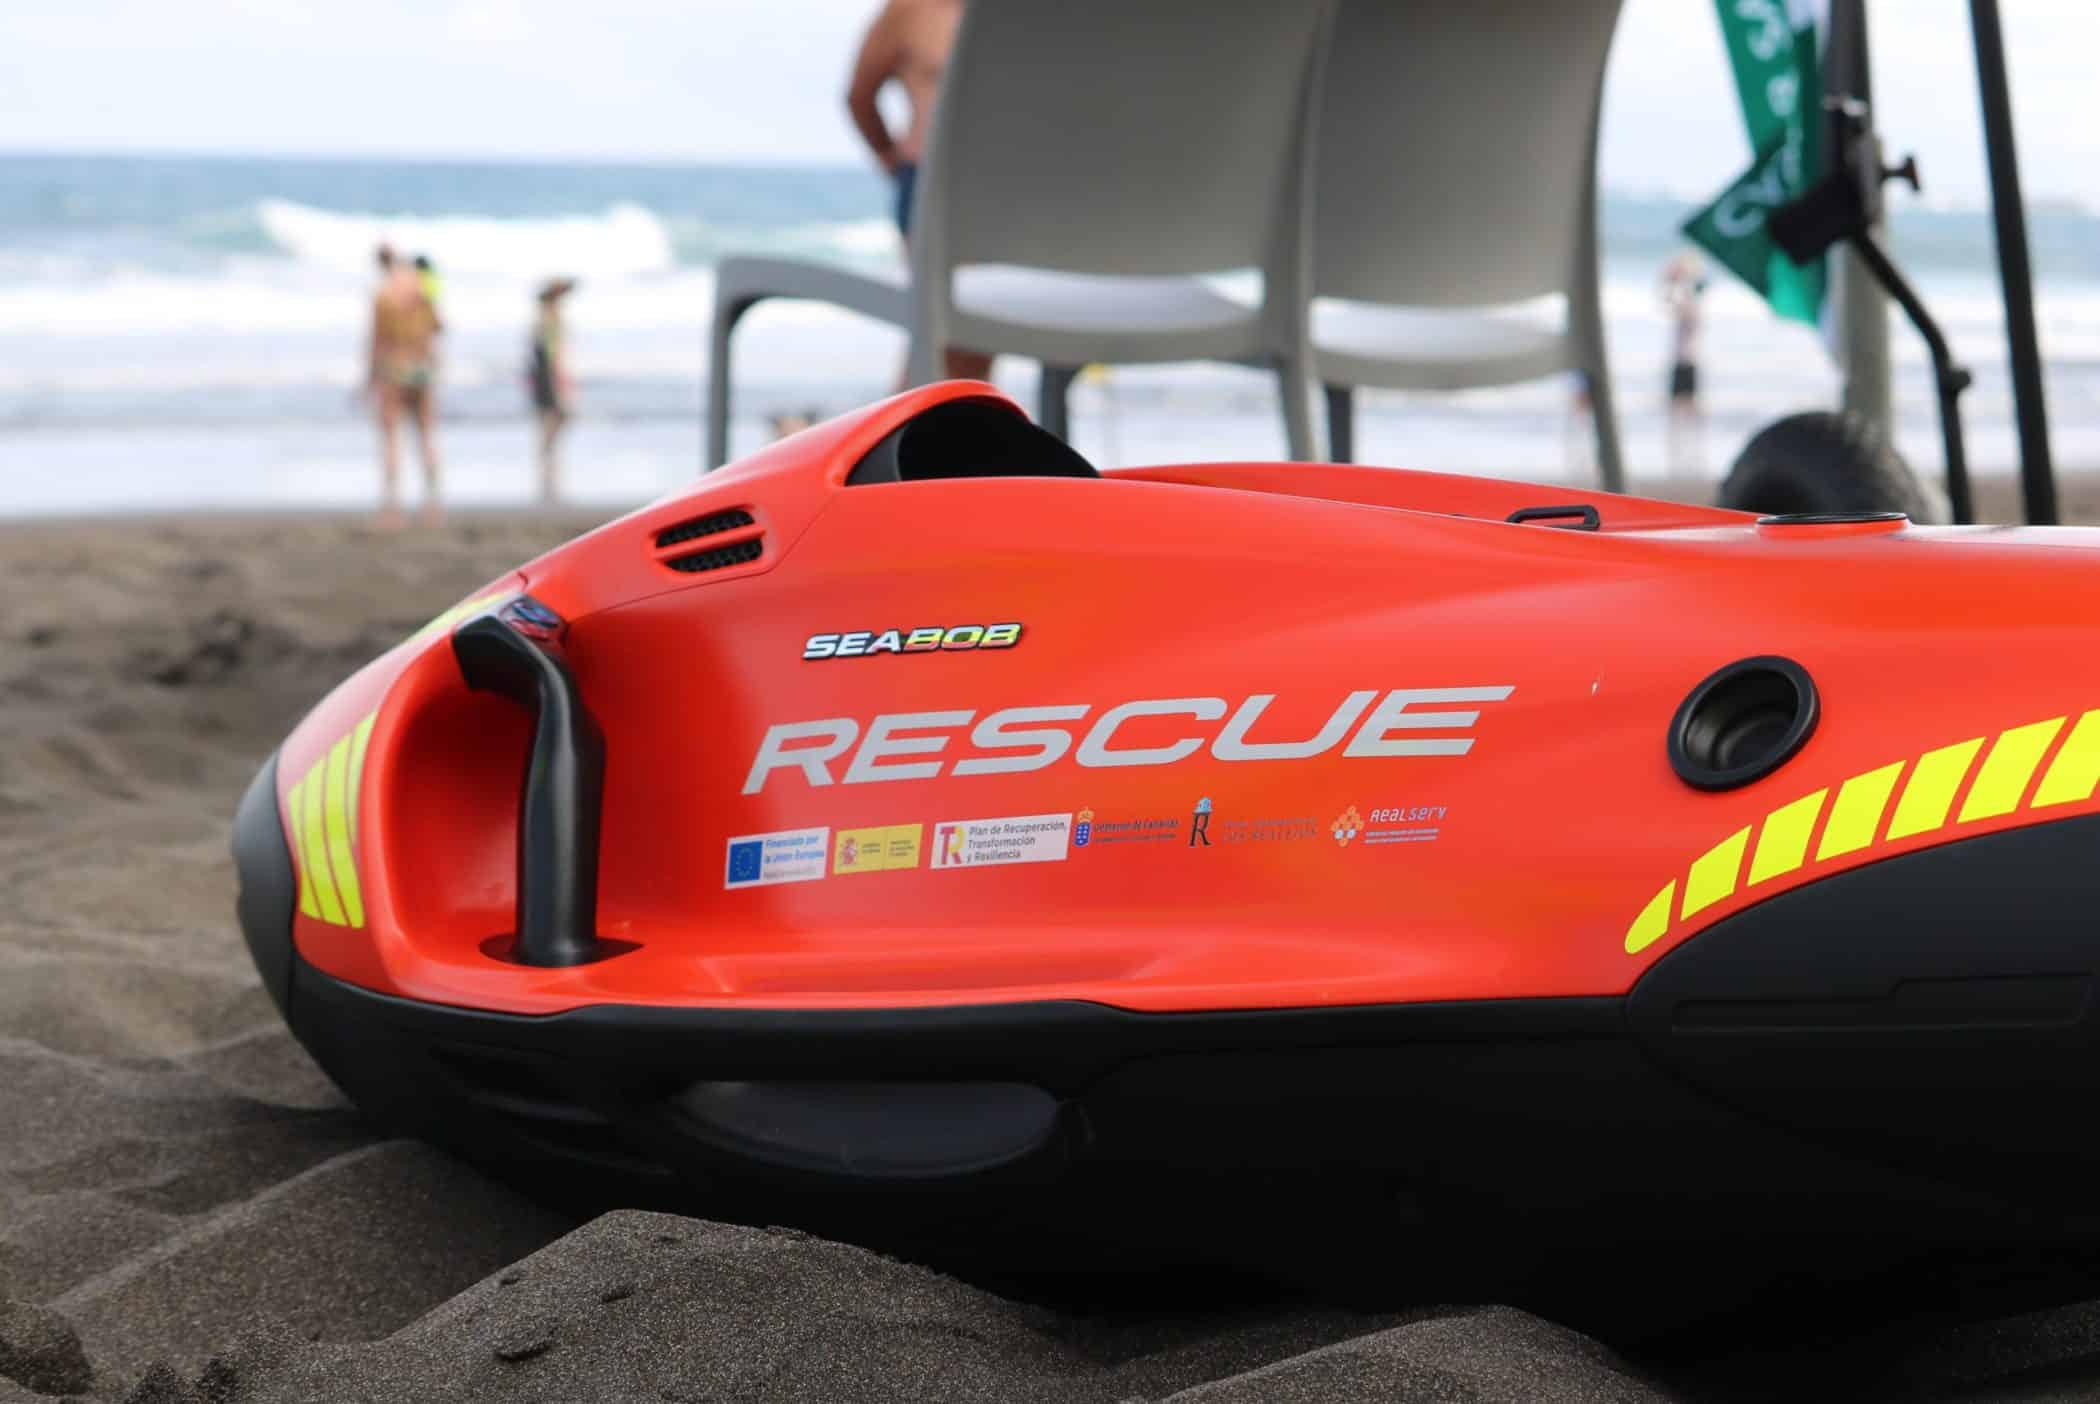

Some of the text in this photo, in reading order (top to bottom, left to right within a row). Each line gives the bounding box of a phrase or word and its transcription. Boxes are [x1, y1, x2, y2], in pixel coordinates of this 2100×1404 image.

[802, 623, 1023, 660] SEABOB
[741, 686, 1516, 795] RESCUE
[968, 820, 1067, 836] Plan de Recuperación,
[967, 835, 1036, 849] Transformación
[974, 848, 1021, 860] Resiliencia
